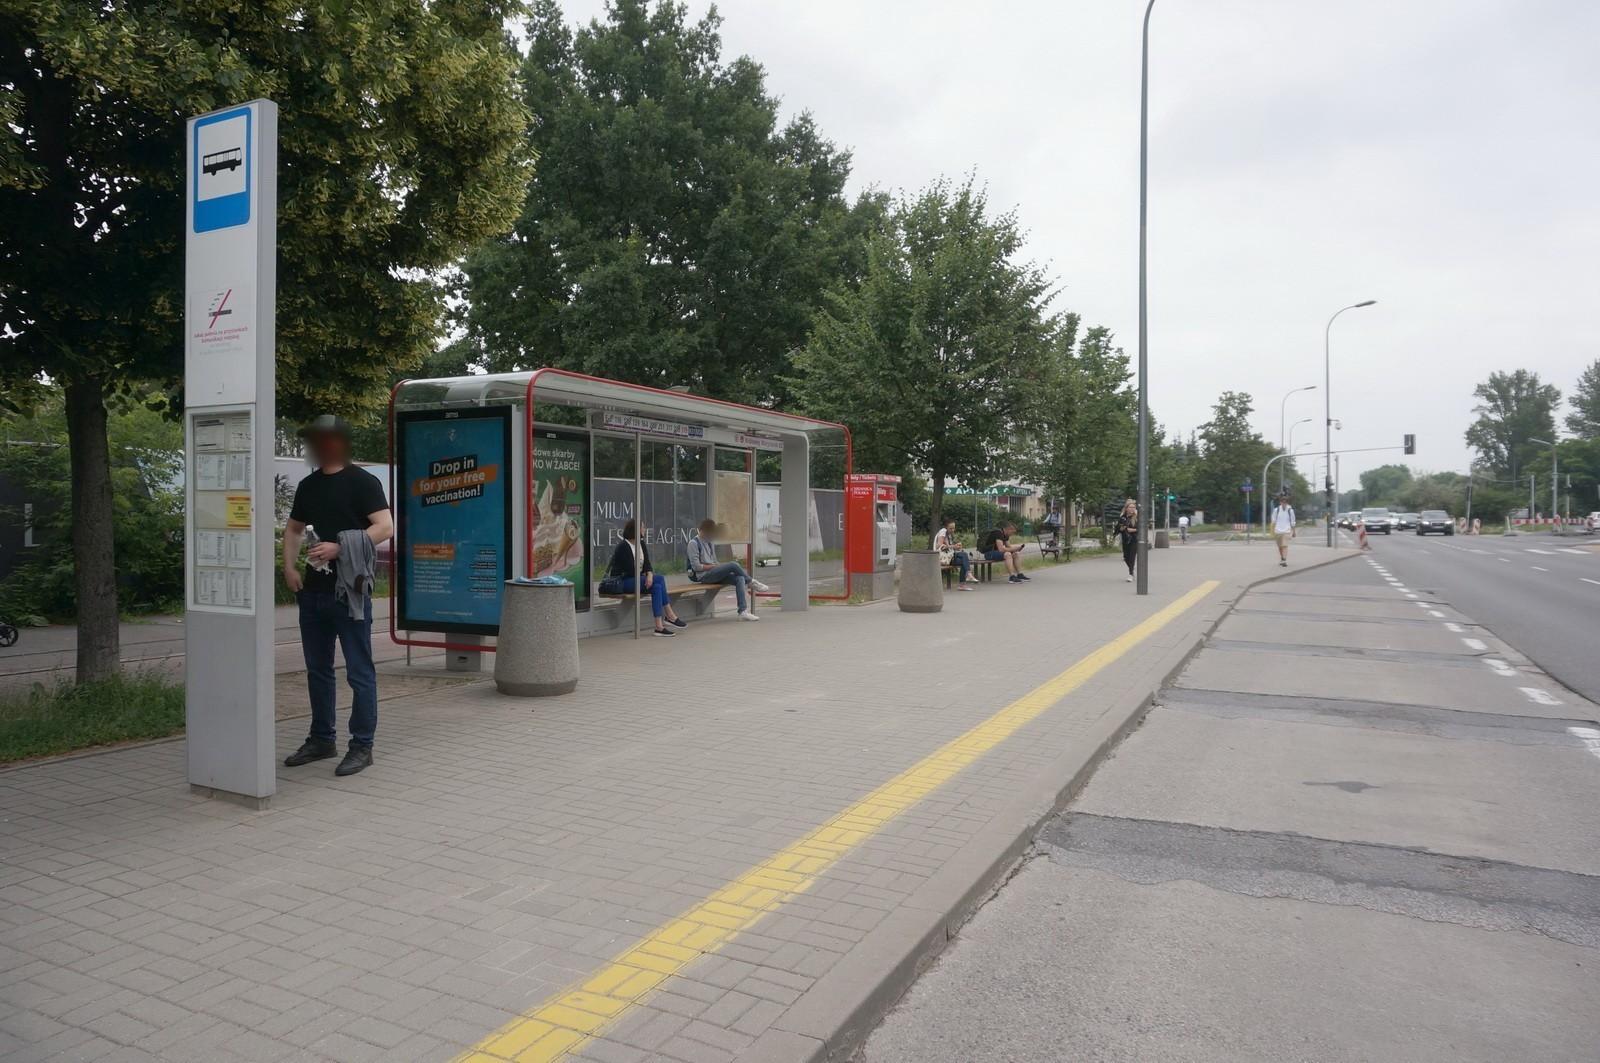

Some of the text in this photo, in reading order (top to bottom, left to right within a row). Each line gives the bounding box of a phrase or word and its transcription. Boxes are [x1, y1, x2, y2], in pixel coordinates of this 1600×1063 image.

[545, 460, 553, 470] W
[553, 458, 581, 471] ŻABCE!
[552, 448, 576, 461] skarby
[433, 456, 475, 476] Drop in
[420, 471, 486, 492] for your free
[425, 484, 481, 505] vaccination!
